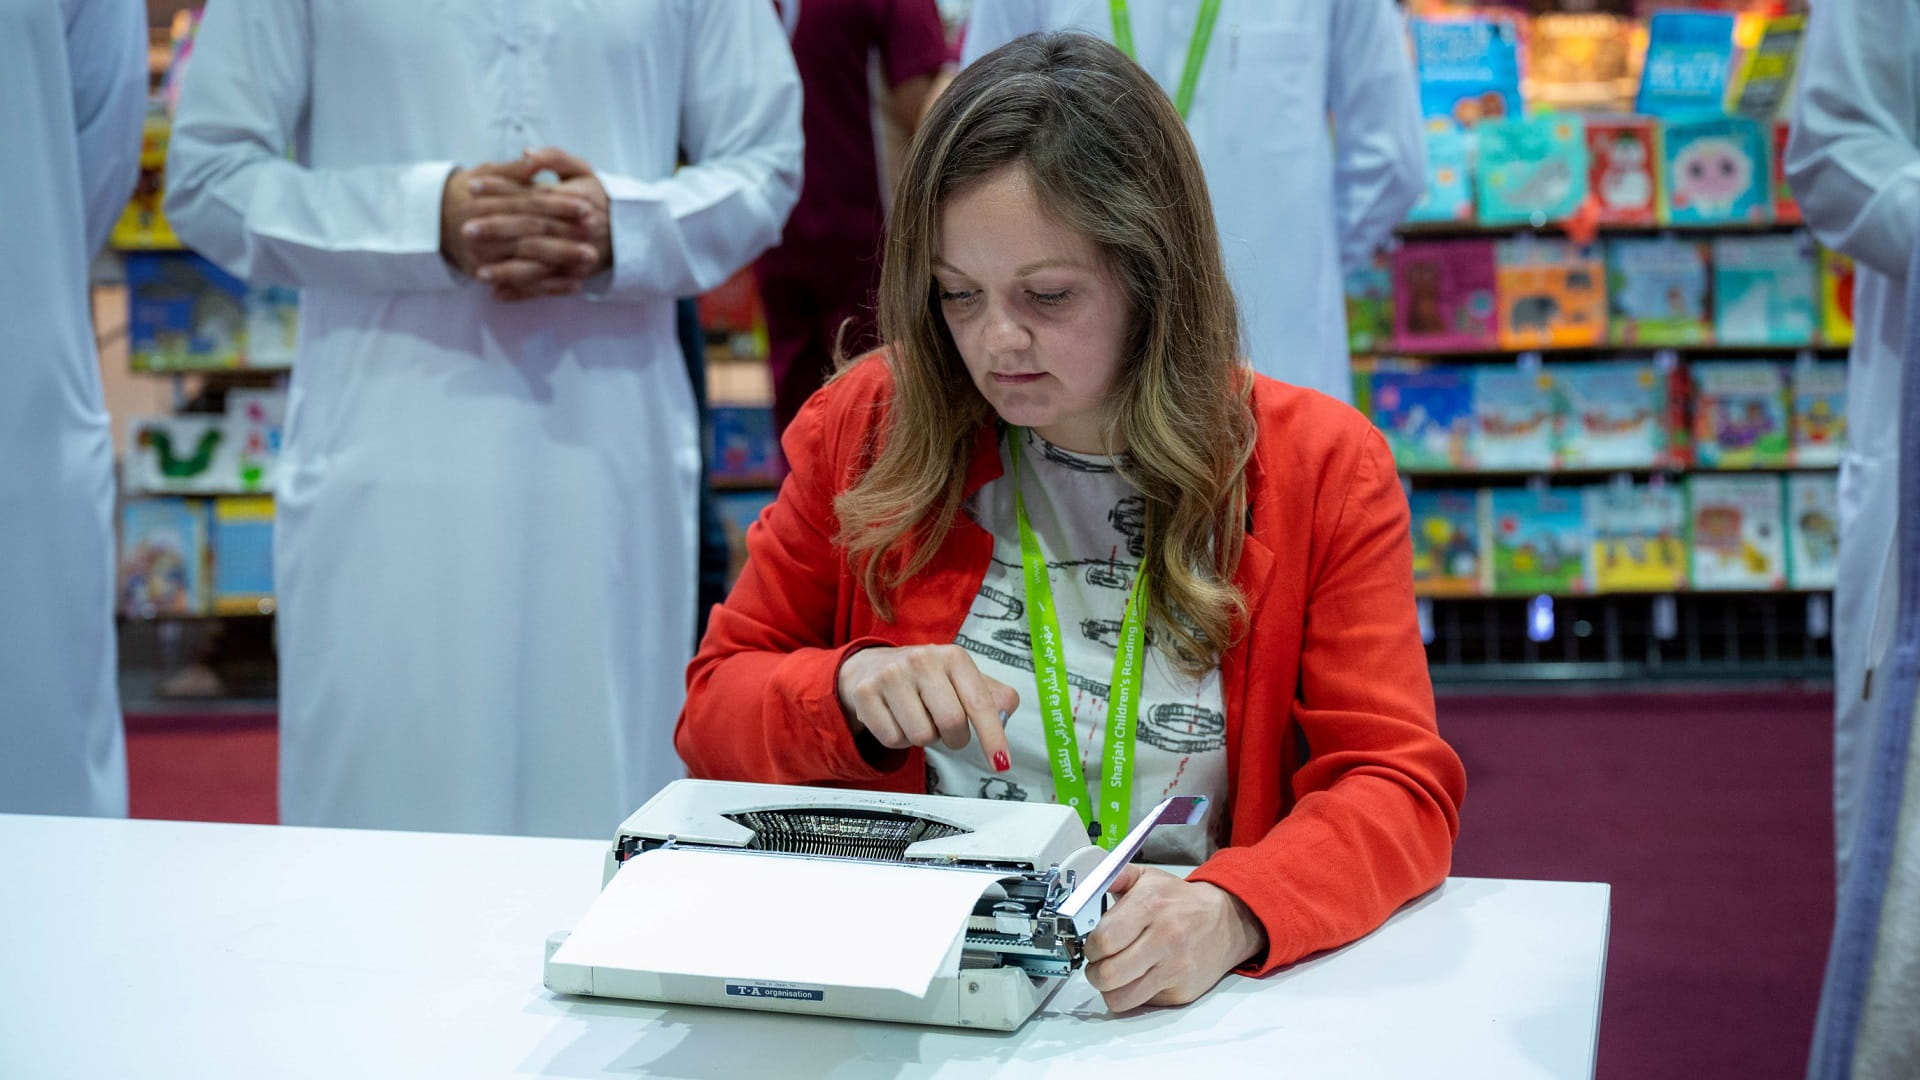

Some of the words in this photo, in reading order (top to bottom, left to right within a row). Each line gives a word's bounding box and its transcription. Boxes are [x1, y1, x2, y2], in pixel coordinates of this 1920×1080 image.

[1110, 739, 1126, 788] Sharjah
[1121, 626, 1138, 676] Reading
[764, 989, 813, 998] organisation
